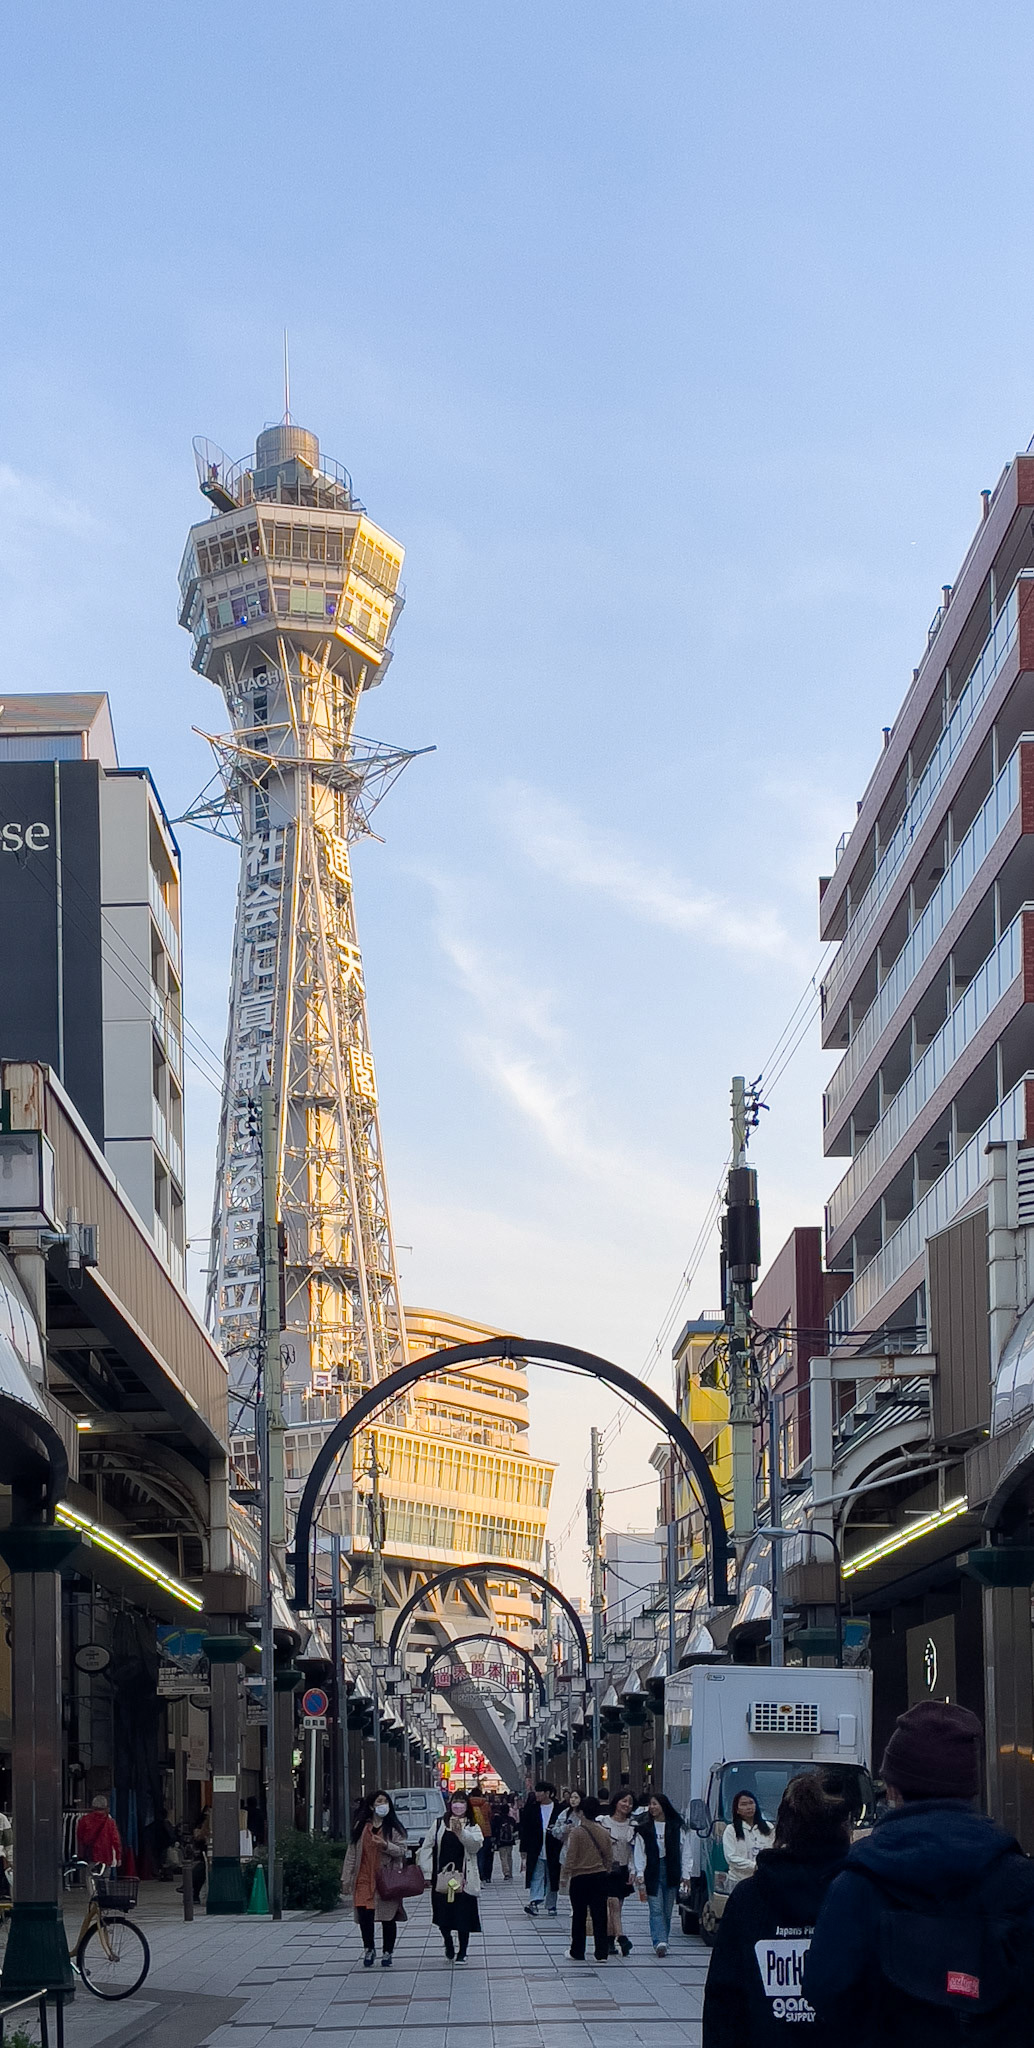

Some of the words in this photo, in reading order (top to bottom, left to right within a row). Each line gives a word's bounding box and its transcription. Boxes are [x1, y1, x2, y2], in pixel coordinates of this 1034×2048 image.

[224, 669, 284, 698] HITACHI
[0, 822, 50, 851] se
[323, 830, 380, 1107] 通天閣
[786, 2012, 816, 2022] SUPPLY
